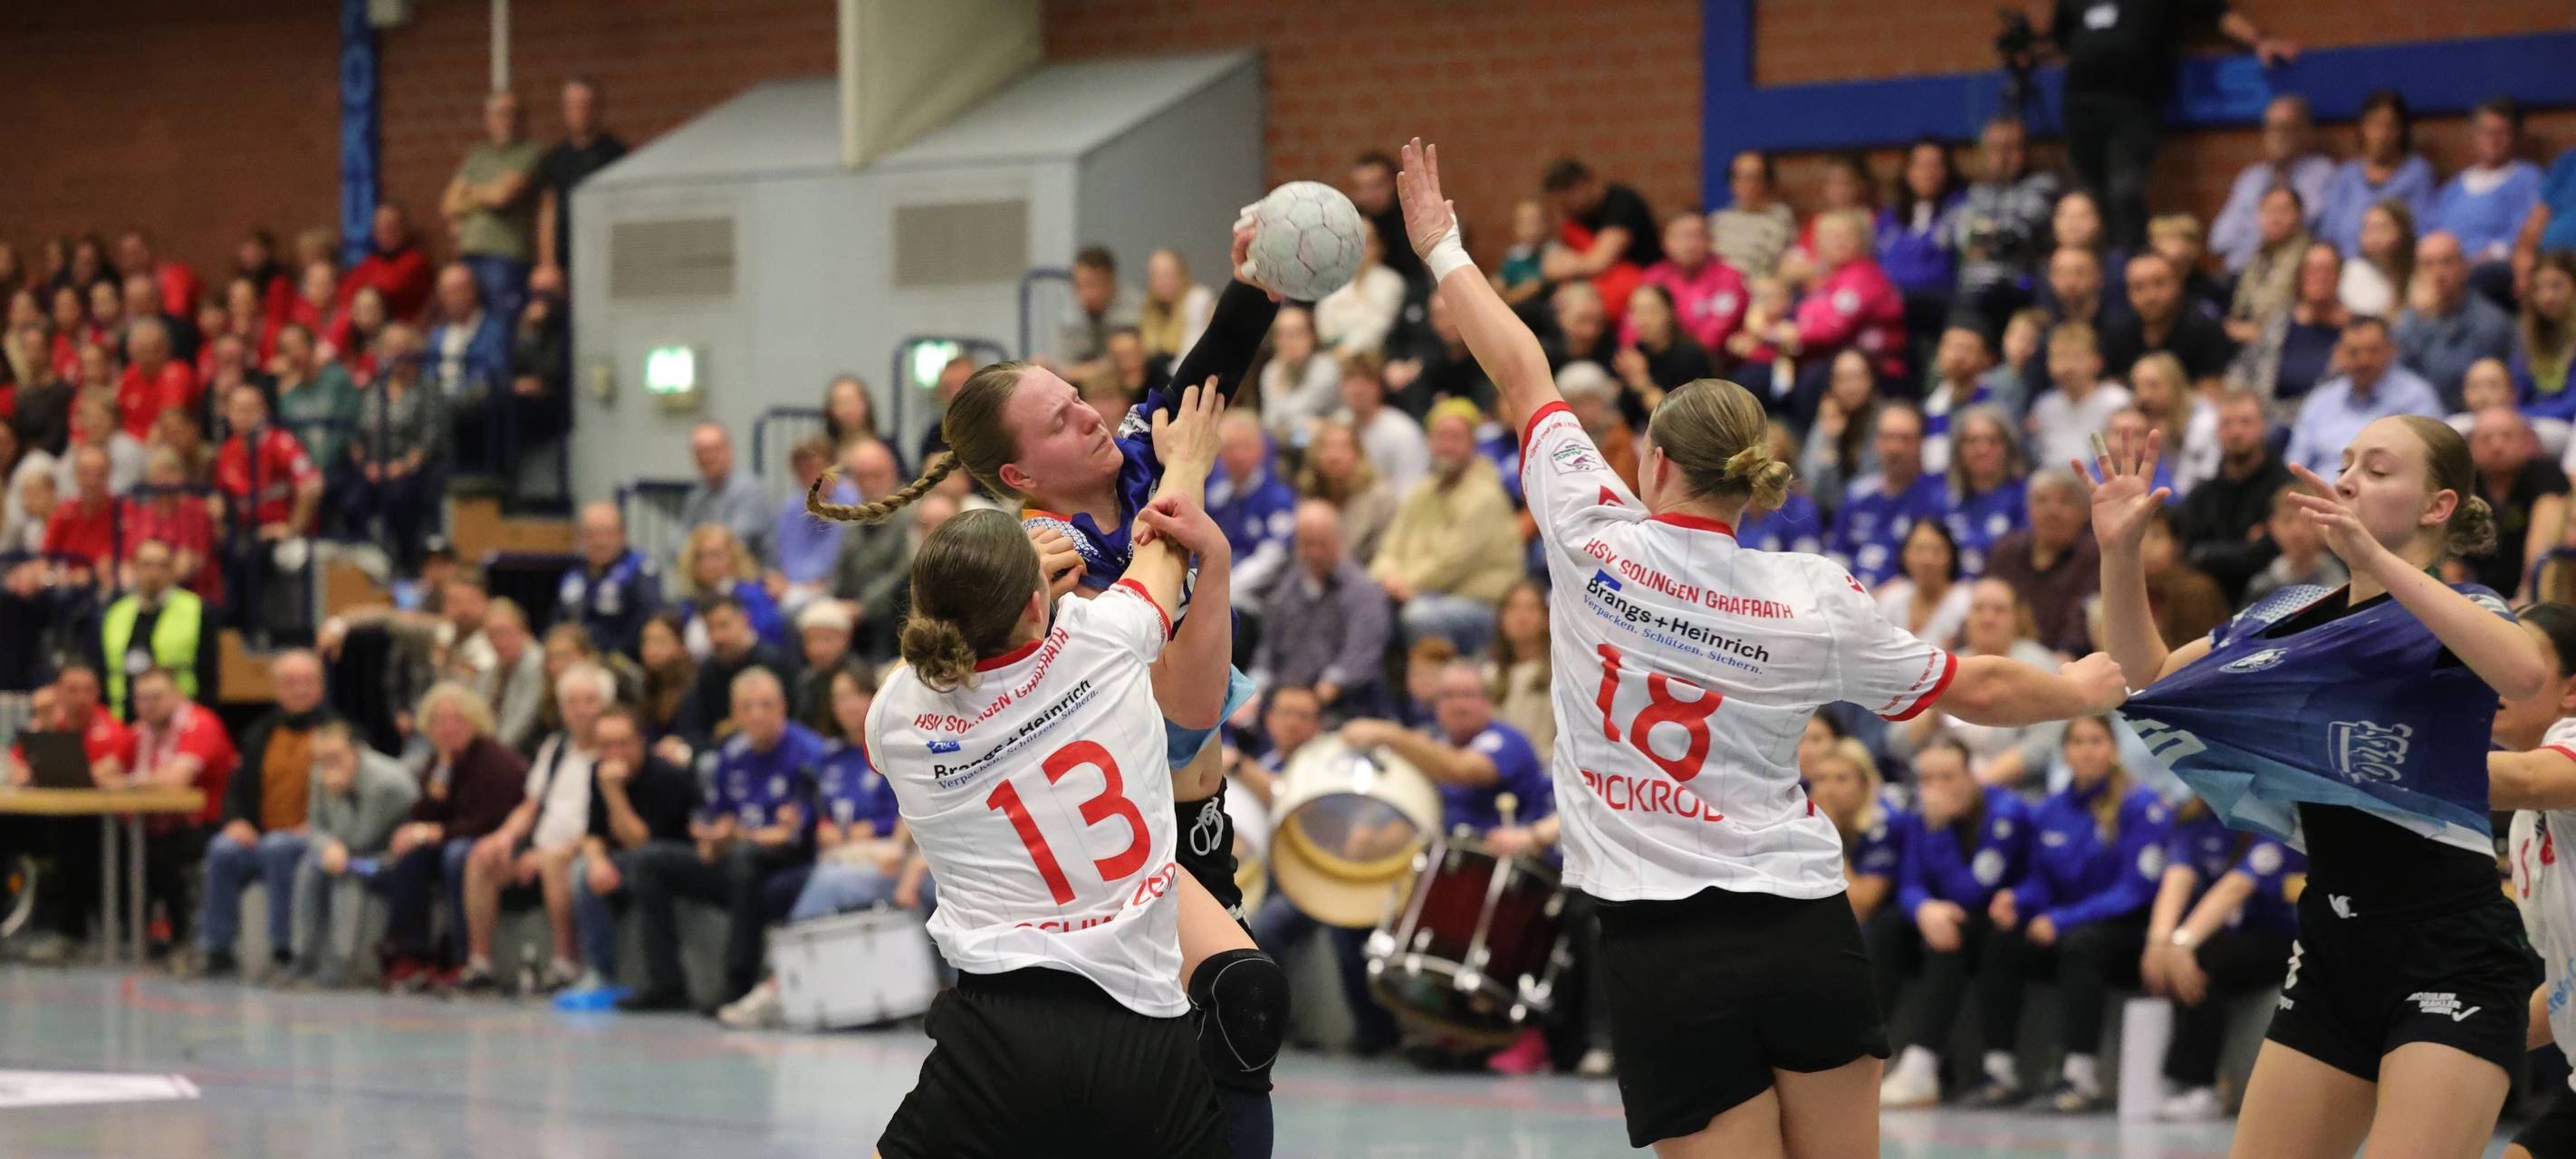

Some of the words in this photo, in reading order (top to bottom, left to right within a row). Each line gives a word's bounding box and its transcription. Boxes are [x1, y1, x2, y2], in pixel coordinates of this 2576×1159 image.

[1583, 537, 1618, 565] HSV
[1619, 559, 1699, 604] SOLINGEN
[1583, 595, 1639, 634] Verpacken.
[1643, 628, 1704, 656] Schützen.
[1707, 651, 1764, 675] Sichern.
[914, 713, 943, 732] HSV
[945, 693, 1012, 734] SOGEN
[1596, 644, 1724, 782] 18
[985, 740, 1151, 905] 13
